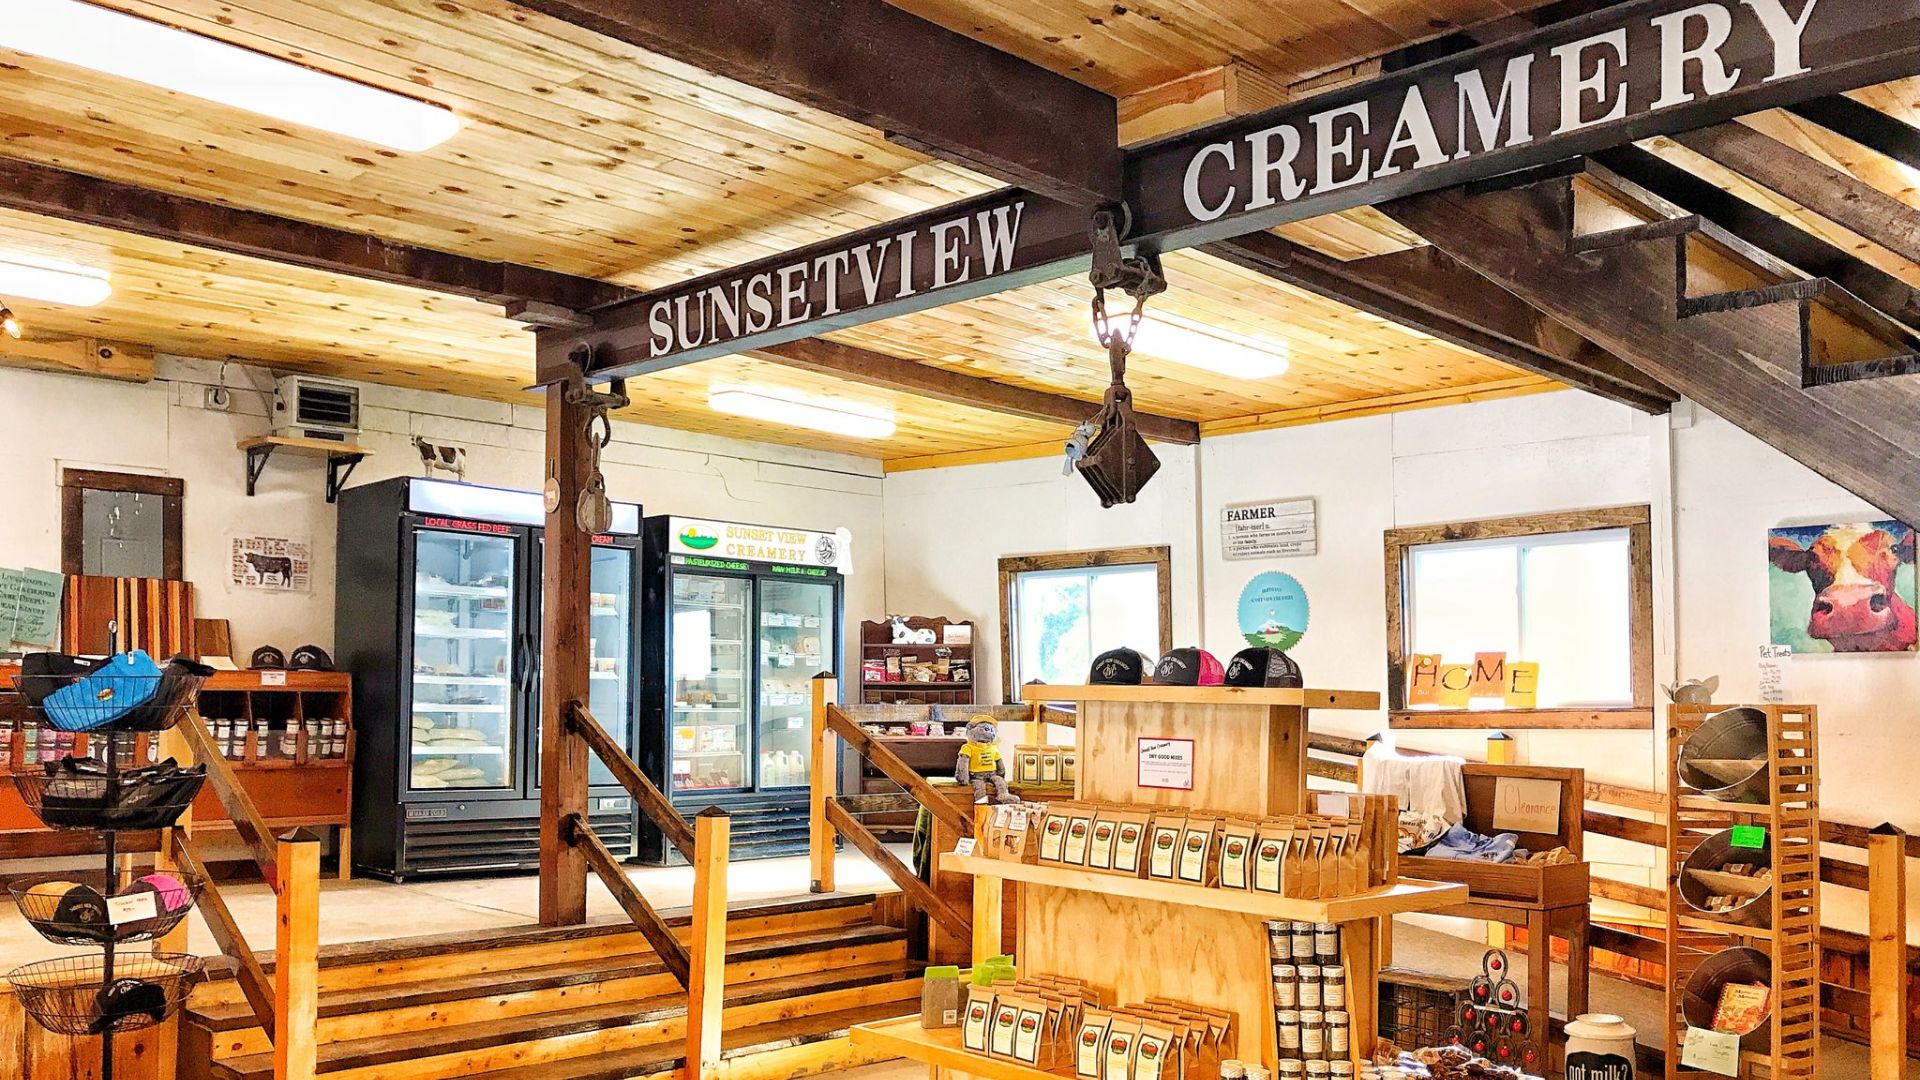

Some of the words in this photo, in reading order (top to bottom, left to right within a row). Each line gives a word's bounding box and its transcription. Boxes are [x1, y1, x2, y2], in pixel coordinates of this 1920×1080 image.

[1182, 0, 1820, 222] CREAMERY
[1227, 507, 1276, 522] FARMER
[425, 516, 448, 527] LOCAL
[451, 520, 477, 530] GRASS
[478, 522, 492, 532] FED
[492, 524, 512, 534] BEEF
[591, 535, 614, 544] CREAM
[726, 526, 774, 542] SUNSET
[777, 531, 808, 545] VIEW
[726, 543, 806, 562] CREAMERY
[725, 561, 750, 570] CHEESE
[806, 568, 828, 577] CHEESE
[1759, 645, 1772, 659] Pet
[1771, 645, 1792, 658] Treats
[1413, 659, 1534, 694] HOME
[1504, 783, 1556, 815] Clearance
[1569, 1063, 1586, 1080] got
[1590, 1063, 1628, 1080] milk?
